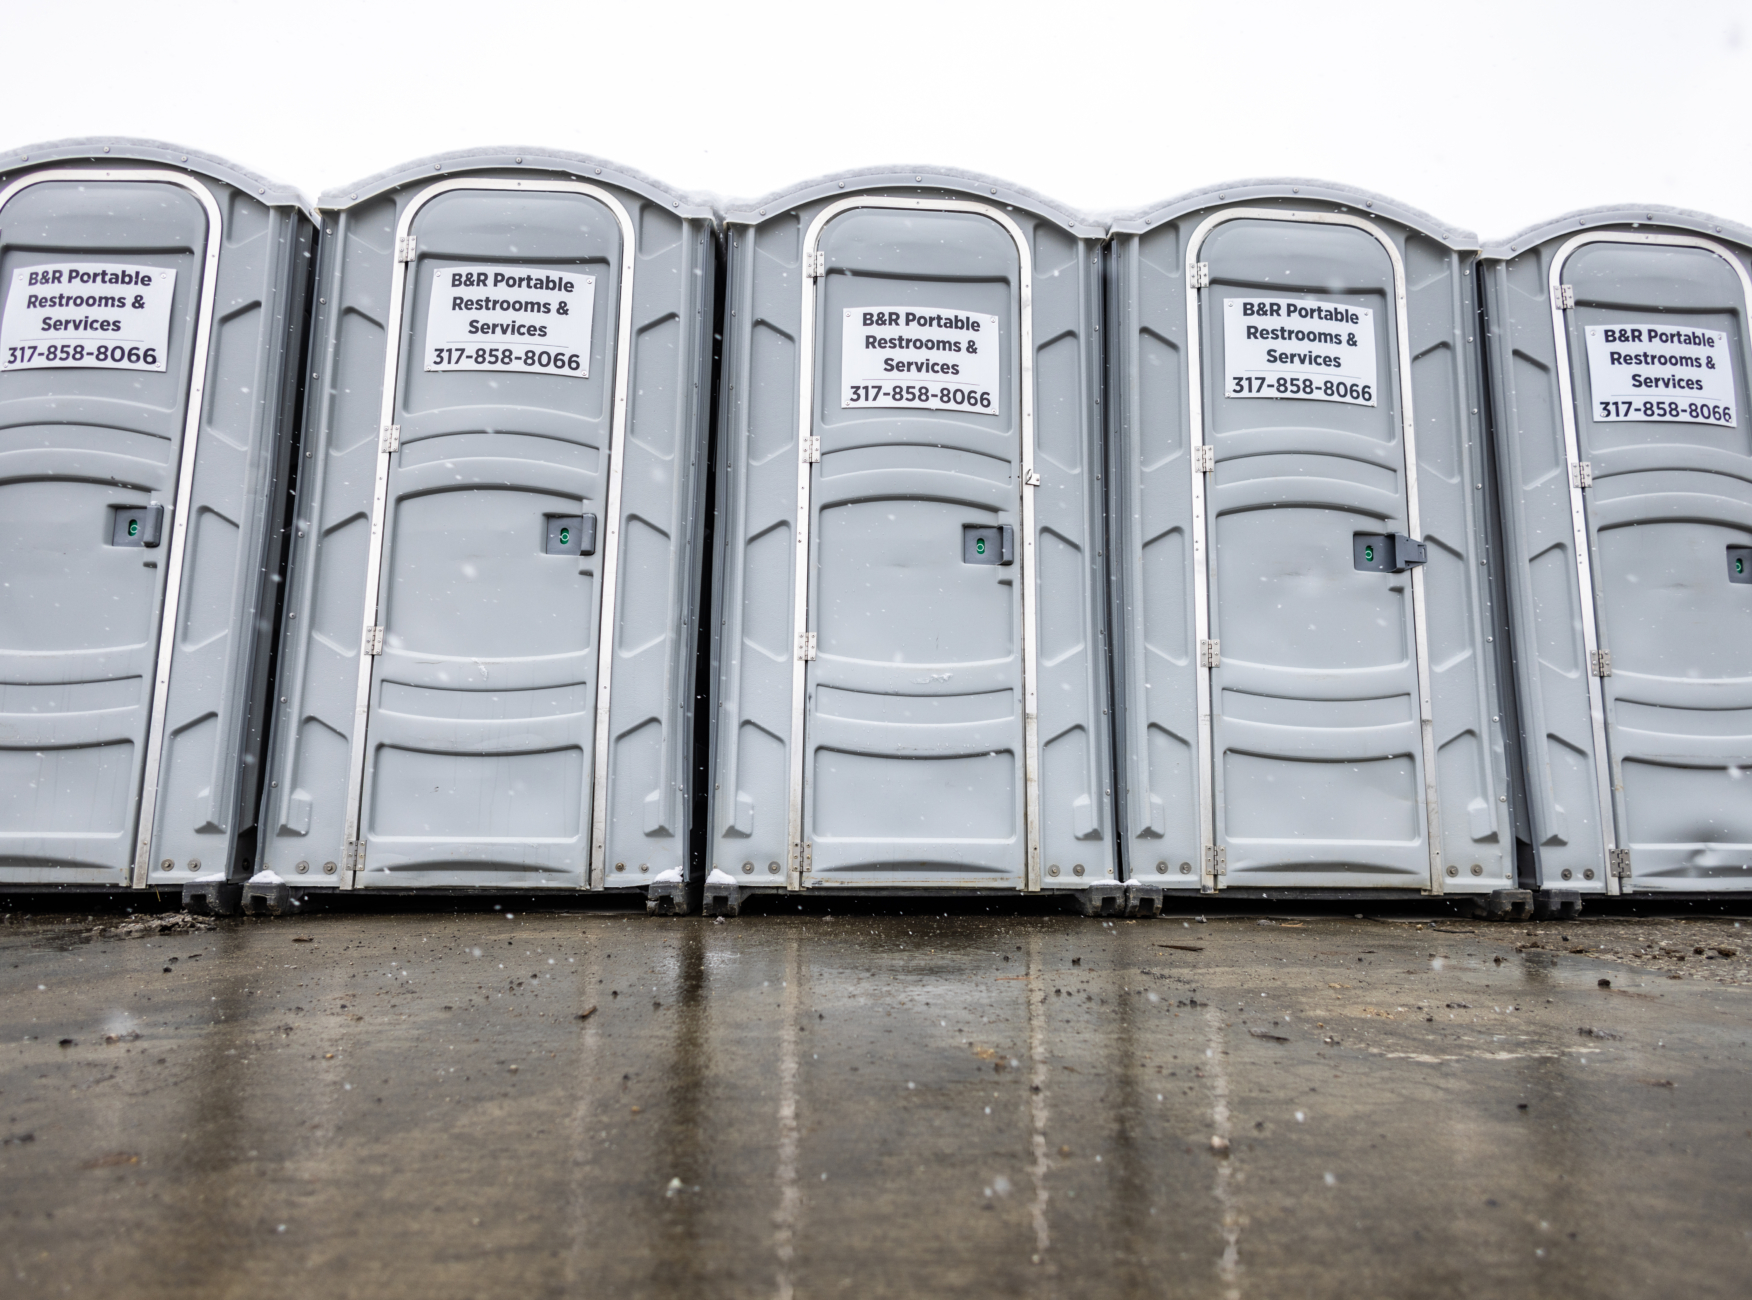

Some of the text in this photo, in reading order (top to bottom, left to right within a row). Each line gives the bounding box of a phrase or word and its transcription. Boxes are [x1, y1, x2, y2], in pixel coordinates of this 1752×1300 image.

[29, 269, 152, 286] B&R Portable
[451, 272, 575, 293] B&R Portable
[27, 293, 145, 309] Restrooms &
[452, 296, 569, 316] Restrooms &
[862, 312, 981, 332] B&R Portable
[1243, 302, 1359, 324] B&R Portable
[41, 316, 121, 331] Services
[468, 320, 547, 337] Services
[865, 335, 978, 354] Restrooms &
[1246, 325, 1358, 347] Restrooms &
[1604, 329, 1715, 347] B&R Portable
[8, 345, 157, 365] 317-858-8066
[433, 348, 580, 370] 317-858-8066
[1266, 349, 1341, 368] Services
[1610, 351, 1716, 370] Restrooms &
[883, 358, 959, 375] Services
[1232, 377, 1372, 401] 317-858-8066
[1631, 374, 1703, 390] Services
[850, 386, 991, 408] 317-858-8066
[1599, 401, 1732, 423] 317-858-8066
